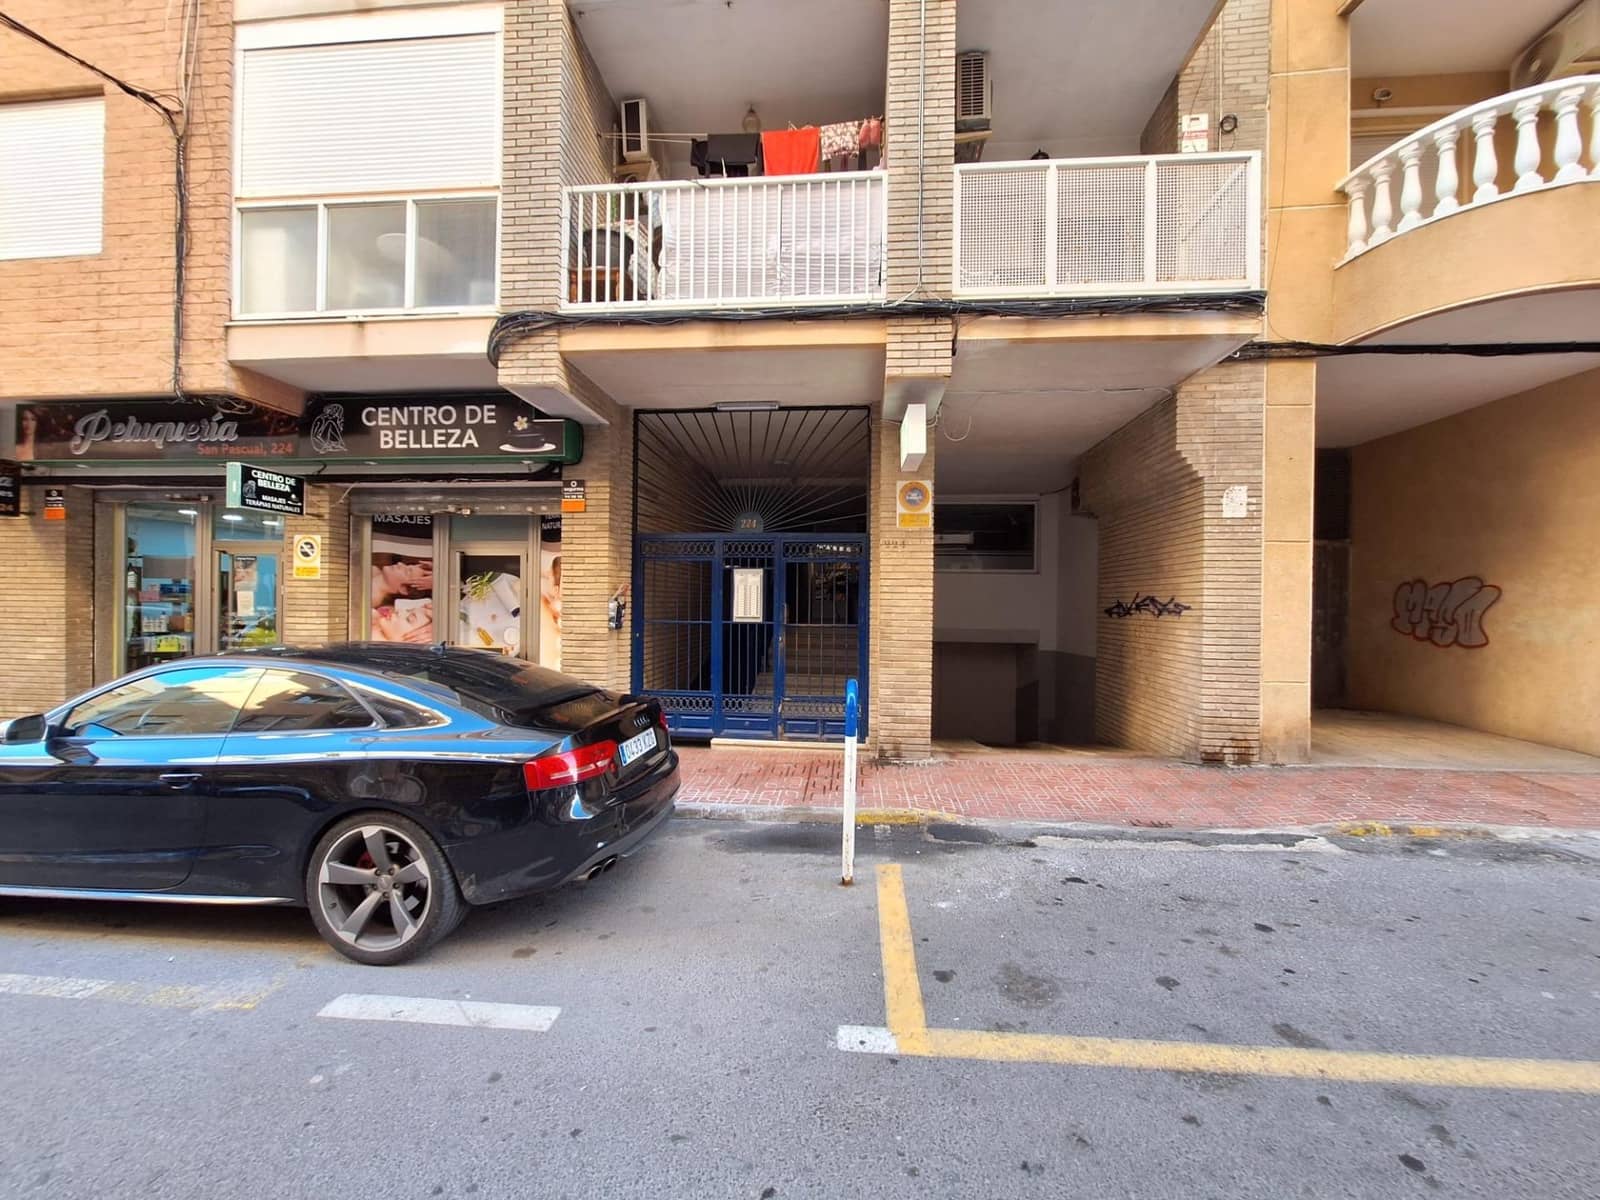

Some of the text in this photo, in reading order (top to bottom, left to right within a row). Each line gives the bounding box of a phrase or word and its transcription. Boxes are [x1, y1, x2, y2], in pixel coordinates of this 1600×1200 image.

[361, 405, 497, 427] CENTRO DE
[70, 409, 238, 455] Peluquería
[379, 428, 479, 449] BELLEZA
[197, 443, 218, 455] San
[271, 441, 294, 454] 224
[251, 469, 297, 487] CENTRO DE
[257, 478, 291, 493] BELLEZA
[261, 494, 286, 505] MASAJES
[373, 512, 431, 525] MASAJES
